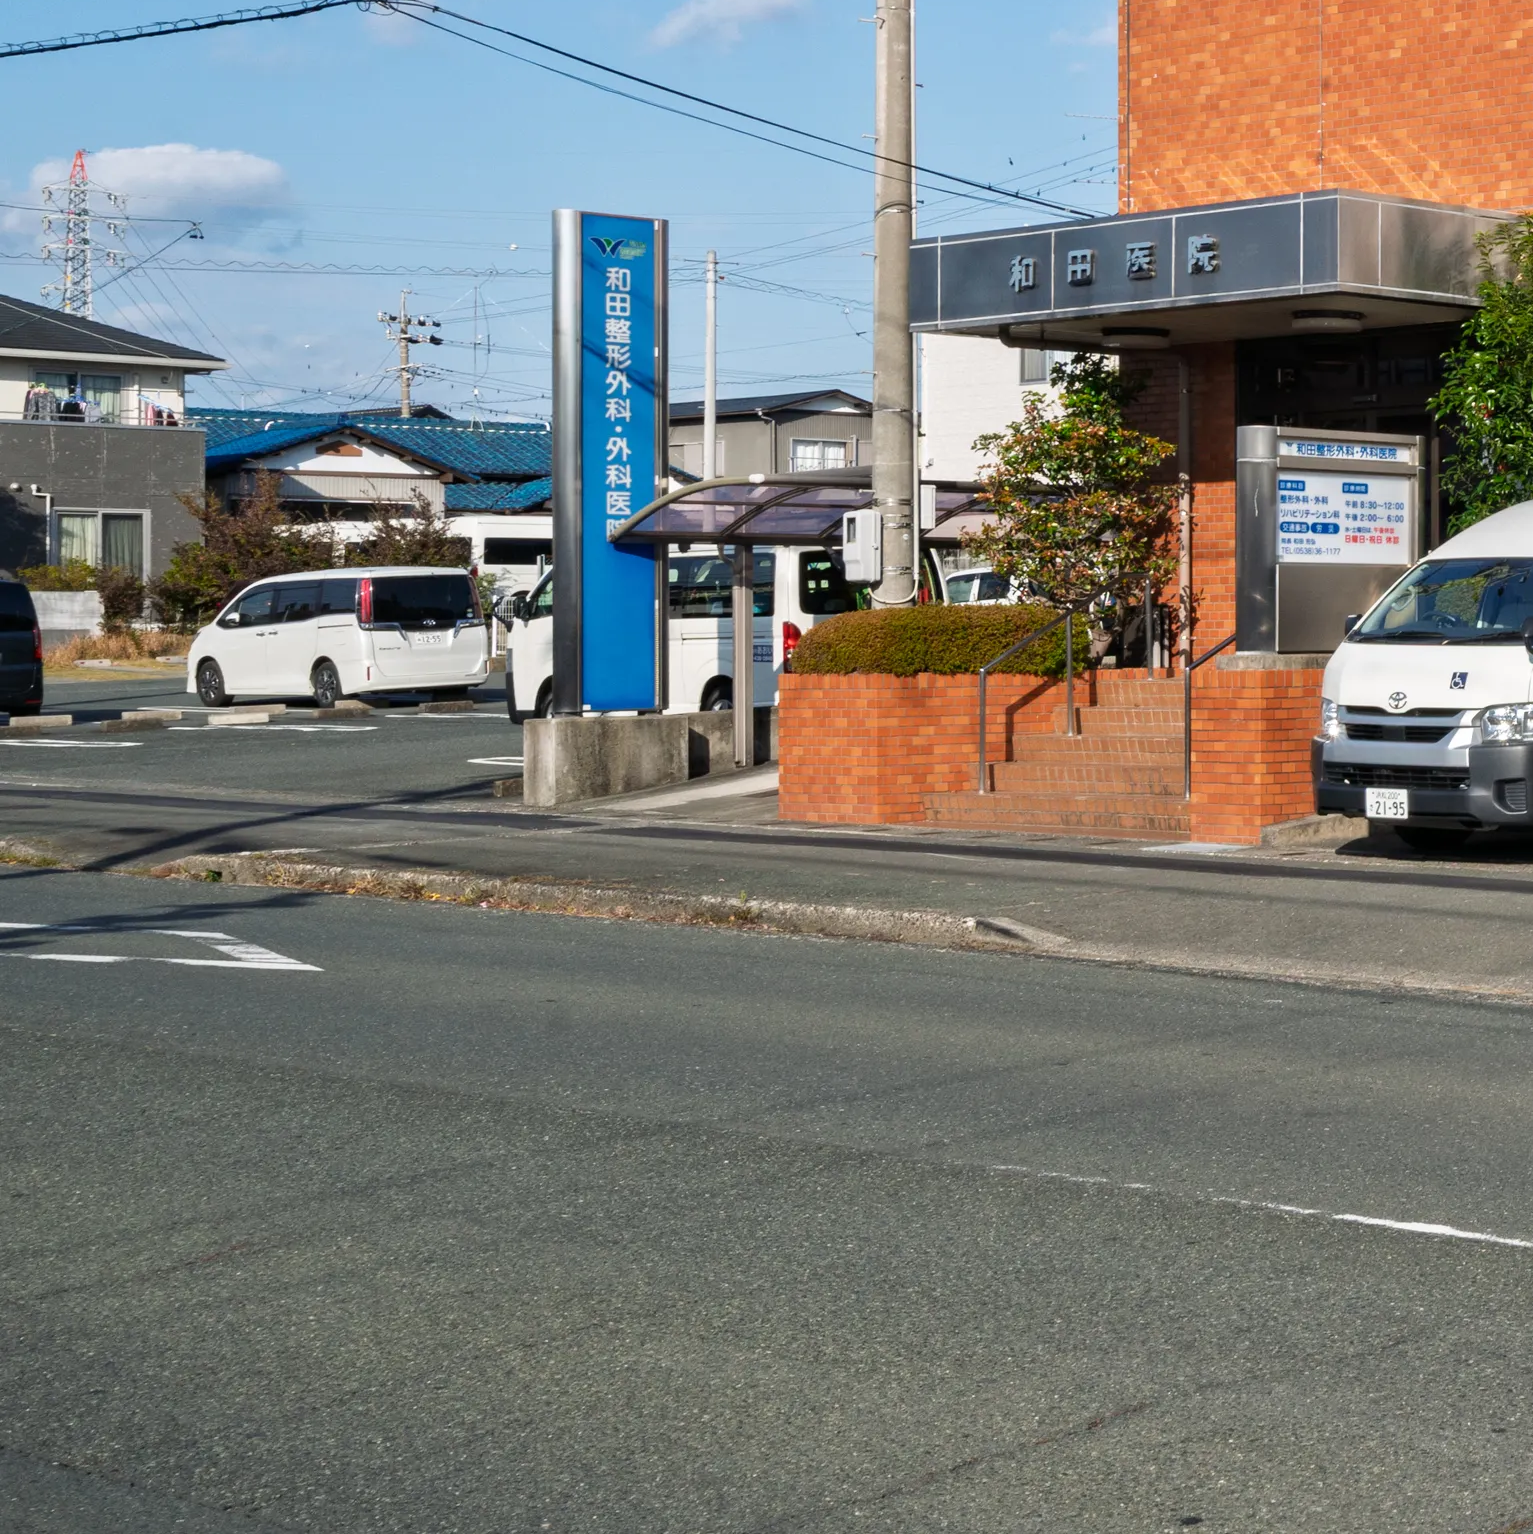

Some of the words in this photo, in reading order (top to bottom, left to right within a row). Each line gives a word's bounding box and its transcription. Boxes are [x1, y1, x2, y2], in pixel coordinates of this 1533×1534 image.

[1009, 234, 1221, 293] 和田医院
[1296, 442, 1398, 460] 和田整形外科・外科医院
[1279, 494, 1329, 505] 整形外科・外科
[1280, 509, 1340, 519] リハビリテーション科
